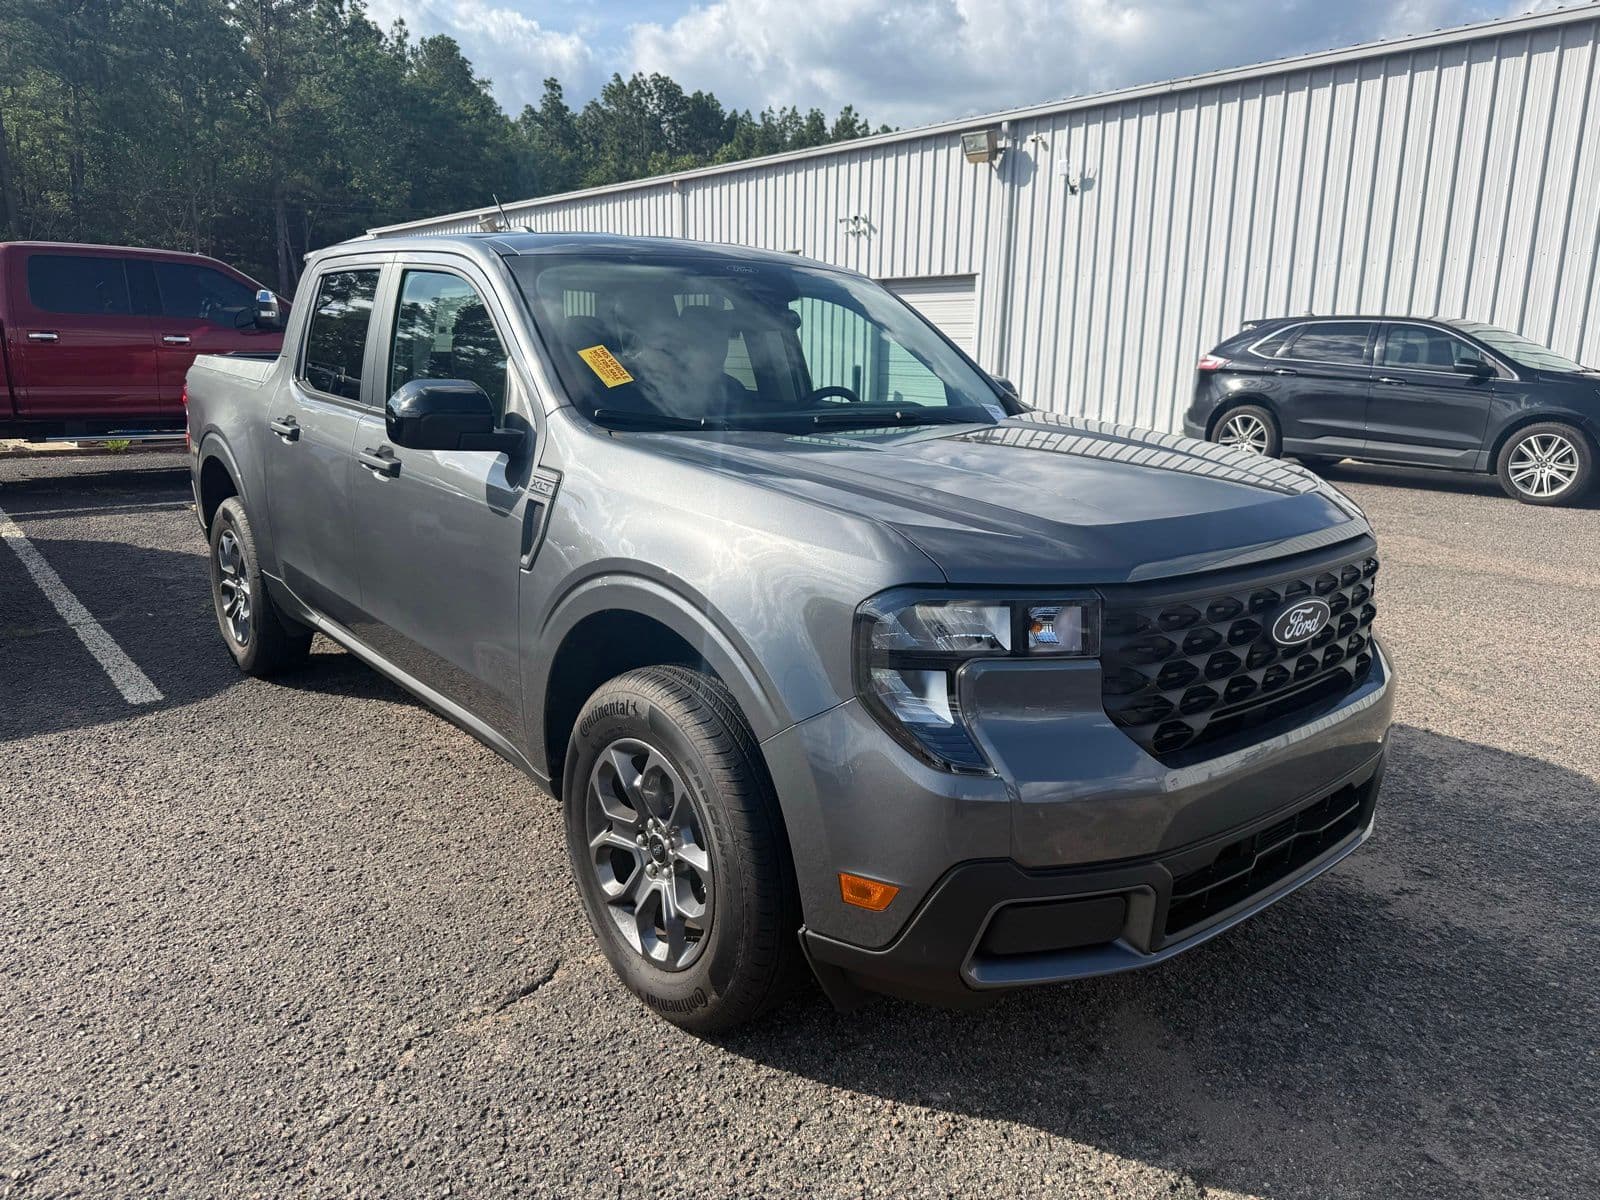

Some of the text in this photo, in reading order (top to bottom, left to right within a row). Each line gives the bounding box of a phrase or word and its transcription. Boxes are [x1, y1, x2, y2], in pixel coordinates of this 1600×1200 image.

[608, 358, 629, 380] VEHICLE
[531, 479, 554, 493] XLT
[1284, 606, 1322, 640] Ford
[580, 699, 630, 738] Continental
[646, 986, 709, 1014] Continental
